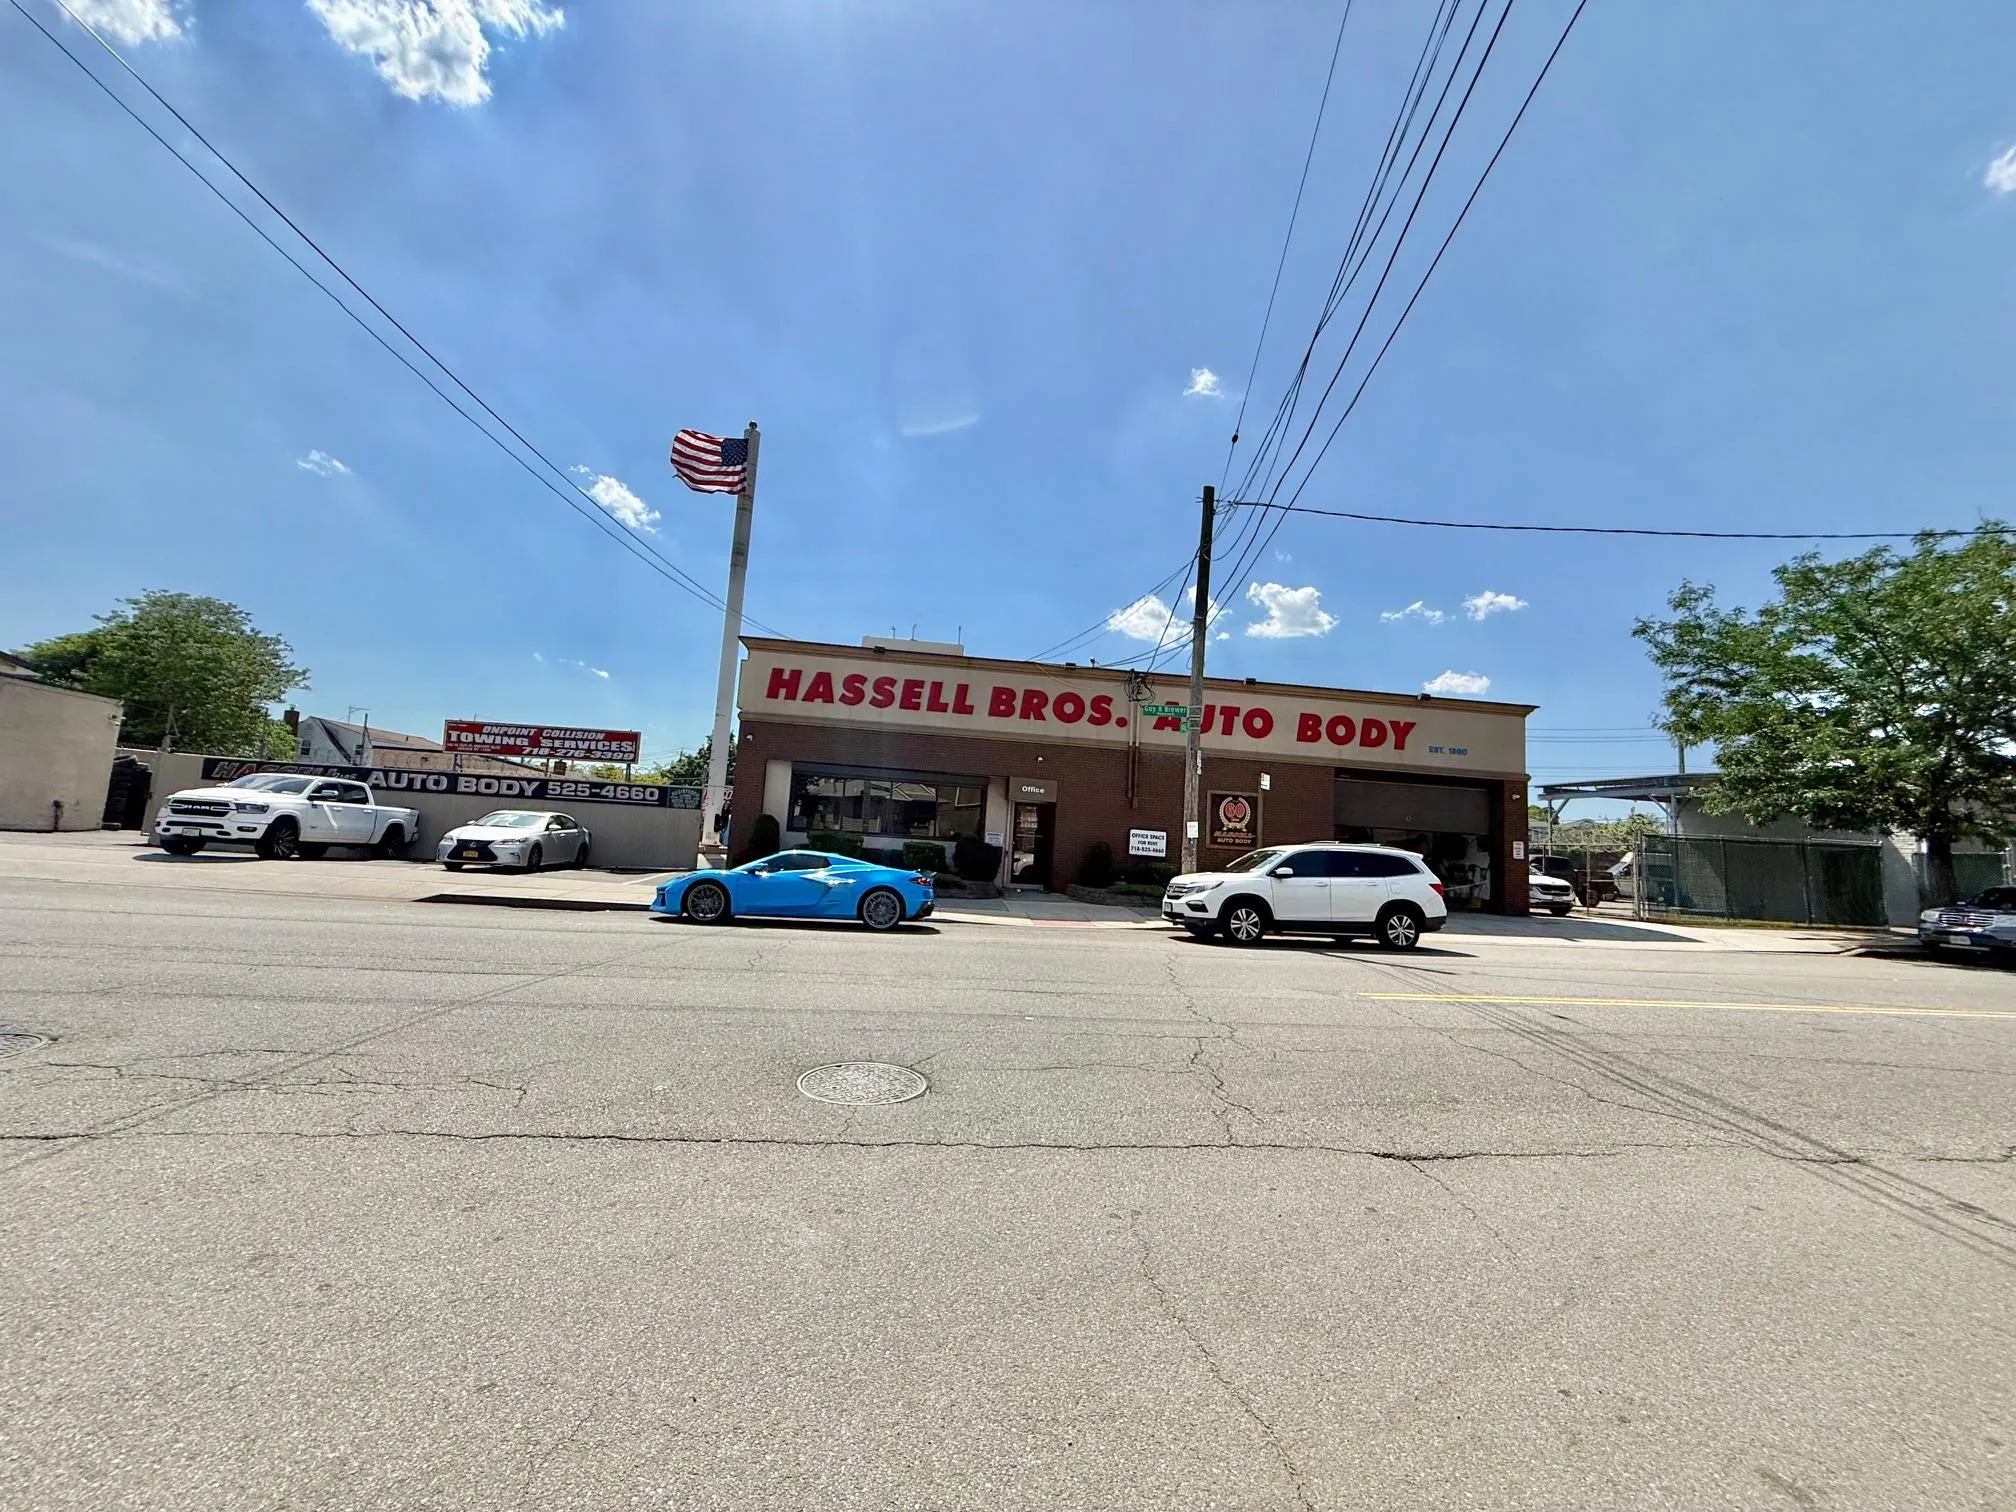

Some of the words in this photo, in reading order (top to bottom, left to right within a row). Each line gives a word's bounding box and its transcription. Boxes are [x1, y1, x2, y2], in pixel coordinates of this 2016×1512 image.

[766, 668, 974, 715] HASSELL
[988, 686, 1128, 728] BROS.
[1296, 713, 1416, 750] BODY
[1144, 705, 1156, 713] Guy
[1165, 706, 1187, 714] Brewer
[482, 725, 537, 736] ONPOINT
[542, 729, 606, 740] COLLISION
[448, 730, 529, 746] TOWING
[541, 739, 633, 752] SERVICES
[522, 746, 635, 760] 718-276-3399
[366, 771, 448, 791] AUTO
[456, 776, 541, 797] BODY
[547, 781, 659, 801] 525-4660
[1021, 785, 1045, 794] Office
[1131, 832, 1149, 840] OFFICE
